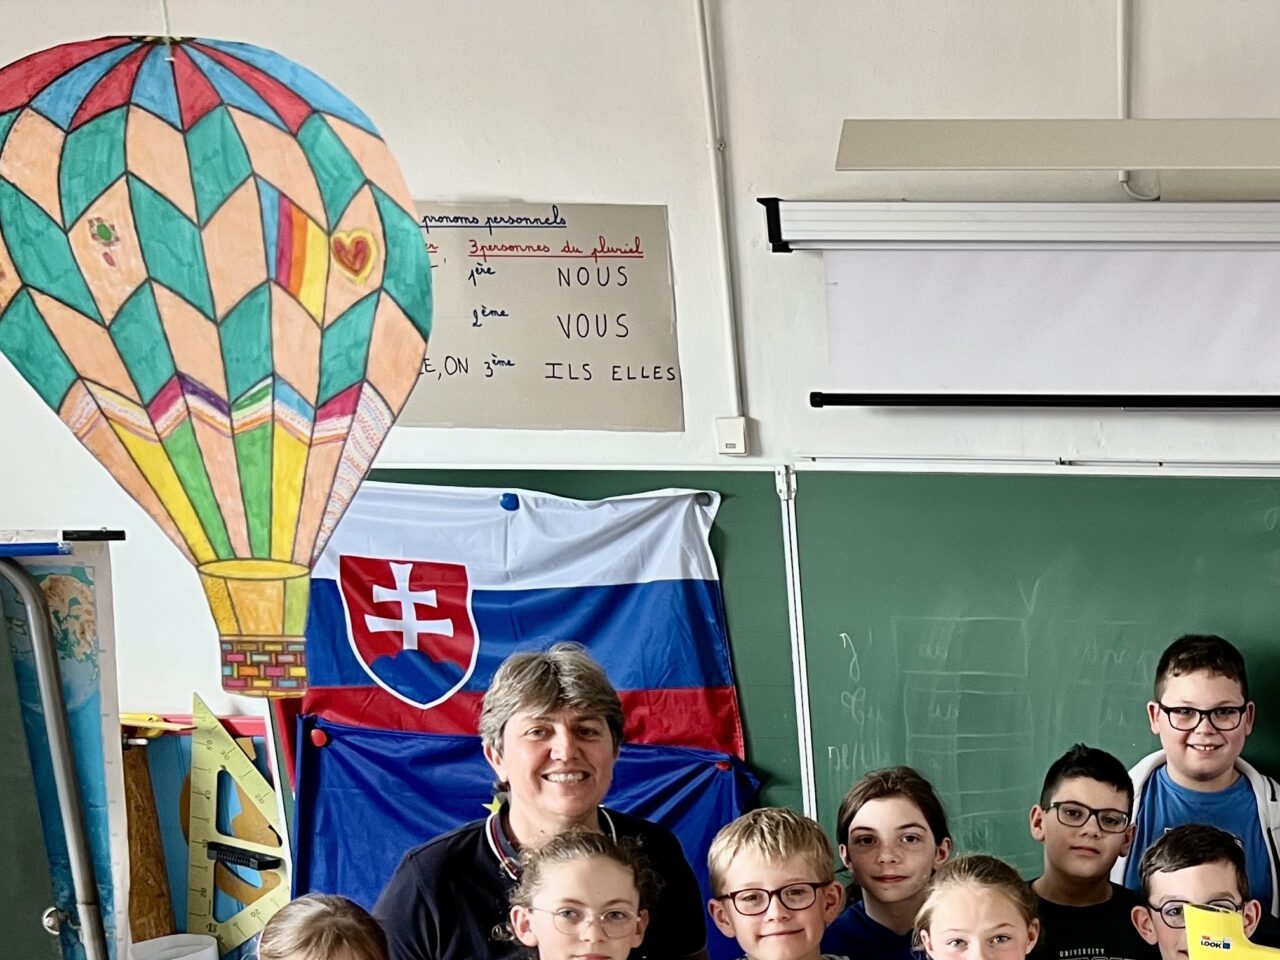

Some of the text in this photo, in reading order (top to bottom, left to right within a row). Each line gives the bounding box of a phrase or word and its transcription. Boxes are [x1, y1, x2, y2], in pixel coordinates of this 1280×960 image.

[422, 205, 567, 236] pronoms personnels
[561, 240, 584, 254] du
[591, 236, 644, 262] pluriel
[557, 266, 630, 288] NOUS
[557, 313, 631, 339] VOUS
[544, 362, 593, 381] ILS
[611, 365, 677, 382] ELLES
[1201, 940, 1222, 949] LOOK
